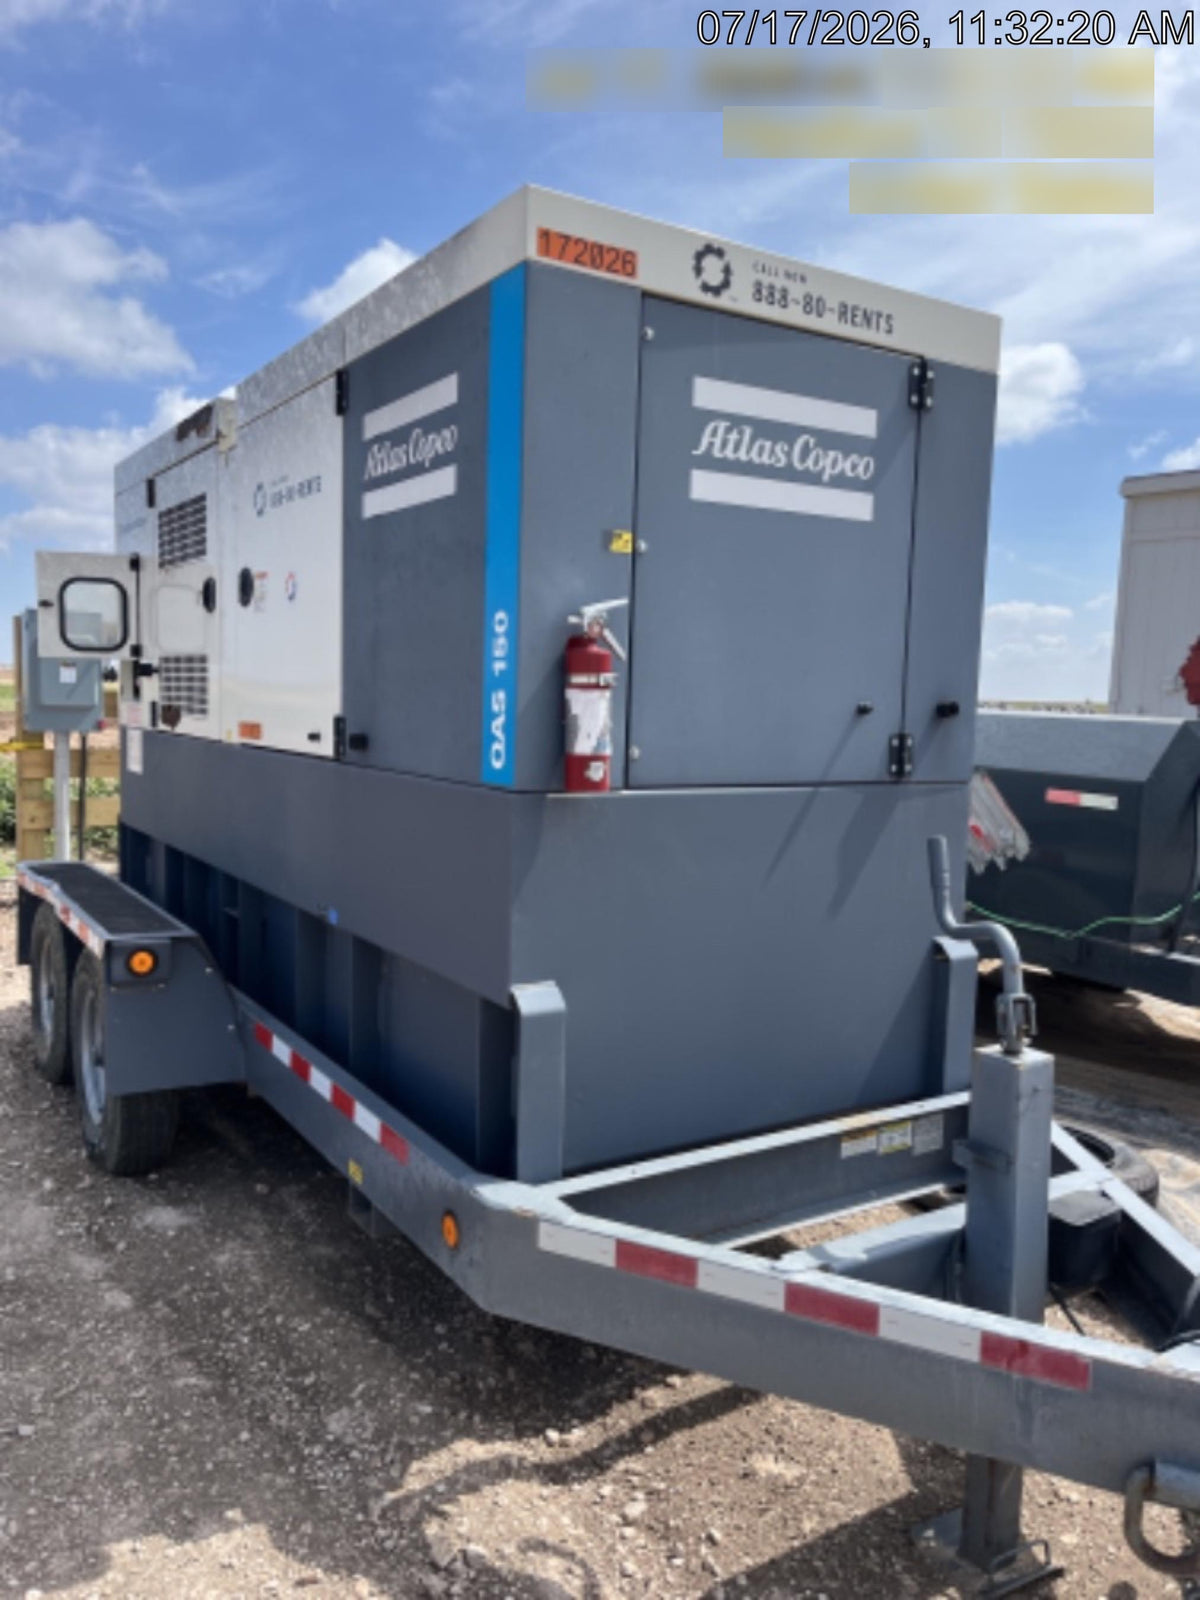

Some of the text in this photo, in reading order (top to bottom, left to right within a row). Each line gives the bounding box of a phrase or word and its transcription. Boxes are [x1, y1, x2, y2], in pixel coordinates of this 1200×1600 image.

[538, 228, 637, 277] 172026
[752, 279, 894, 335] 888-80-RENTS
[691, 420, 875, 483] Atlas Copco
